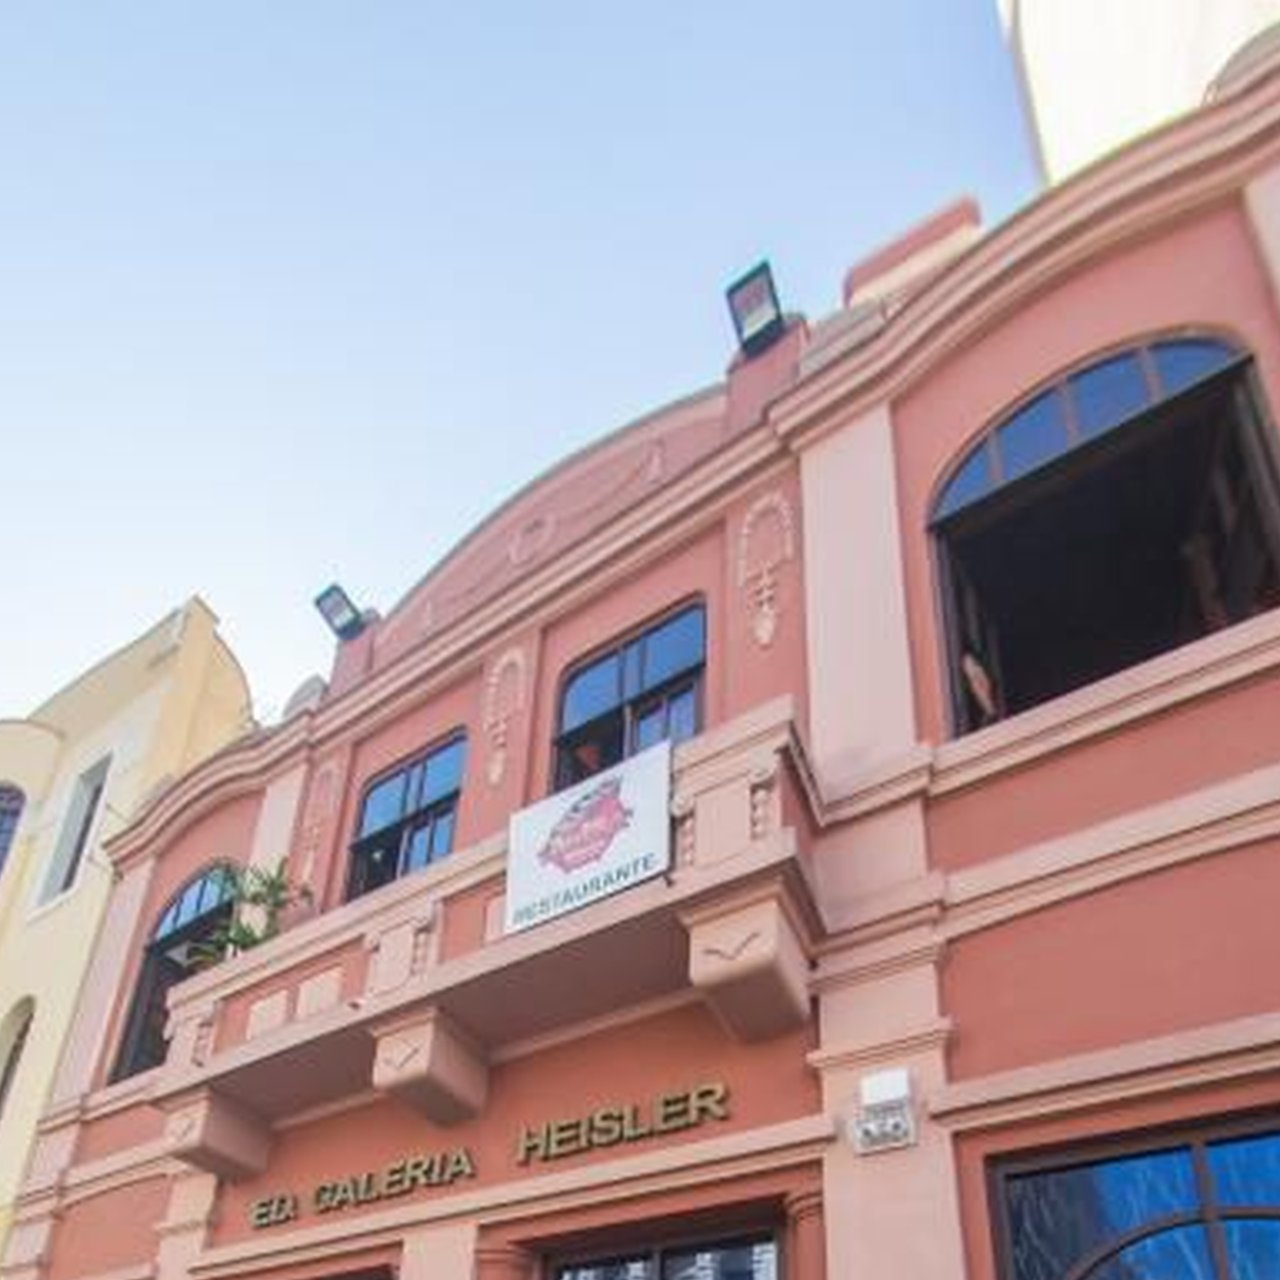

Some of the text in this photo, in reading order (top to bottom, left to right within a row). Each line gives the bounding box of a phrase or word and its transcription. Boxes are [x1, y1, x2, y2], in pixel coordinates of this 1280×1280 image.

[513, 851, 655, 924] RESTAURANTE
[317, 1147, 475, 1213] GALERIA
[517, 1081, 730, 1164] HEISLER
